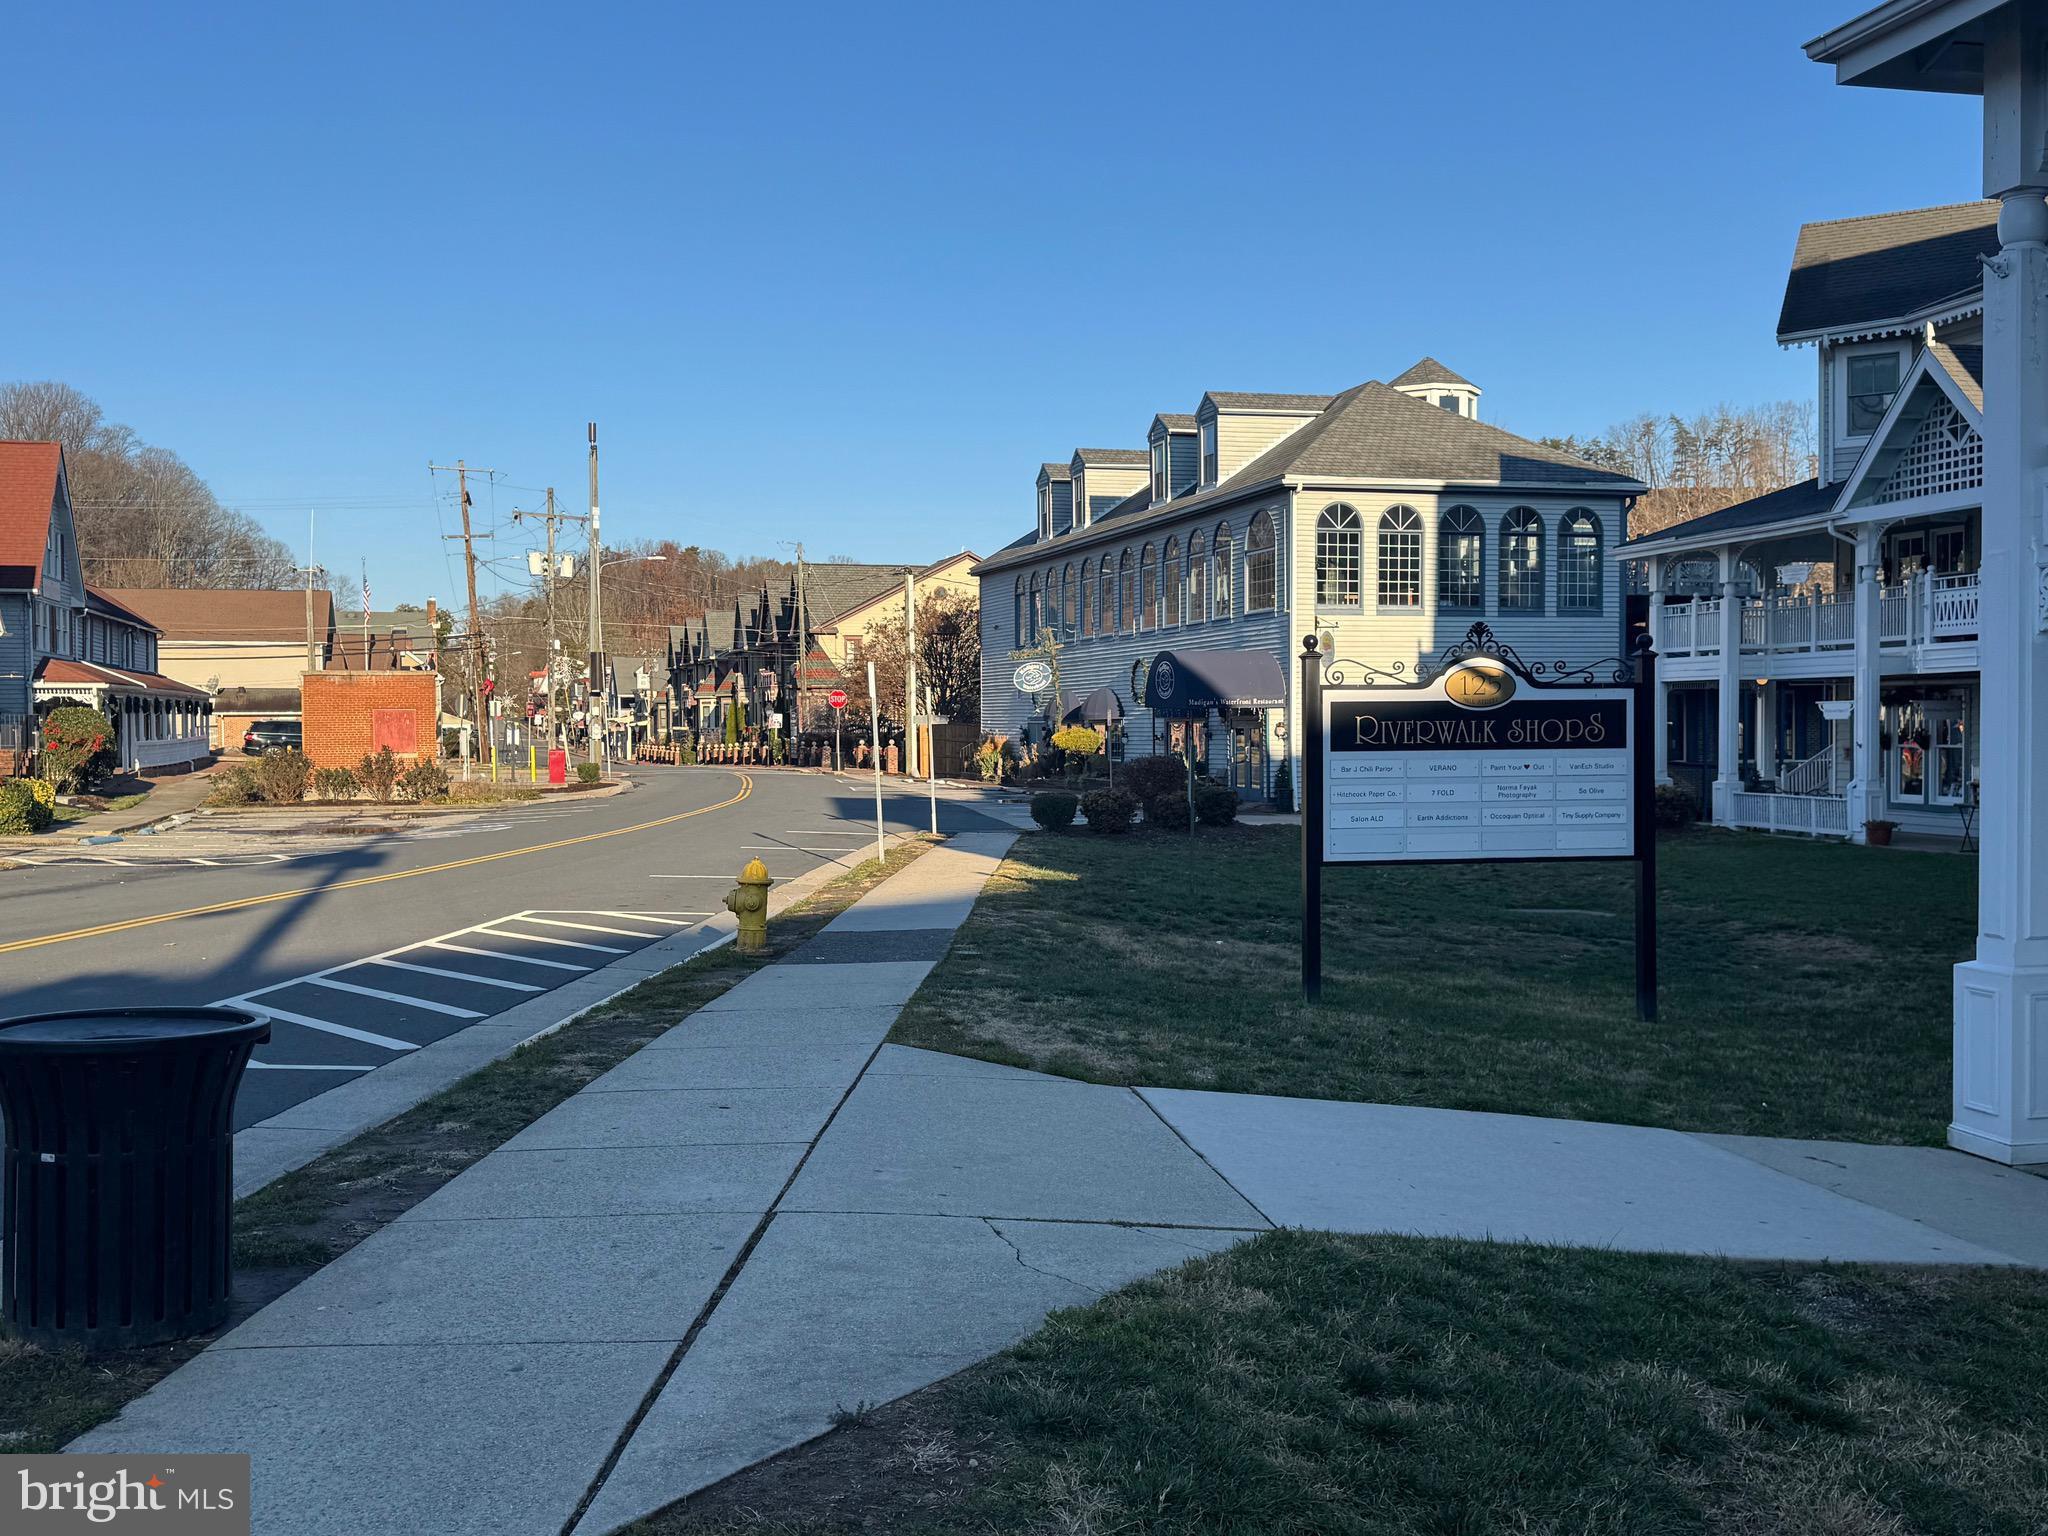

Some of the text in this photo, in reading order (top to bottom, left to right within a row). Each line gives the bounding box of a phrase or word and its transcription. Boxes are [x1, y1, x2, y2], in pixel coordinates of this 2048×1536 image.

[1460, 675, 1501, 696] 125
[830, 695, 846, 703] STOP
[1220, 697, 1251, 705] Waterfront
[1253, 697, 1284, 705] Restaurant
[1507, 713, 1605, 743] SHOPS
[1359, 765, 1374, 773] Chili
[1588, 786, 1605, 794] Olive
[1368, 790, 1385, 799] Paper
[1417, 814, 1434, 822] Earth
[1490, 811, 1545, 820] Occoquan Optical
[1562, 811, 1622, 820] Tiny Supply Company
